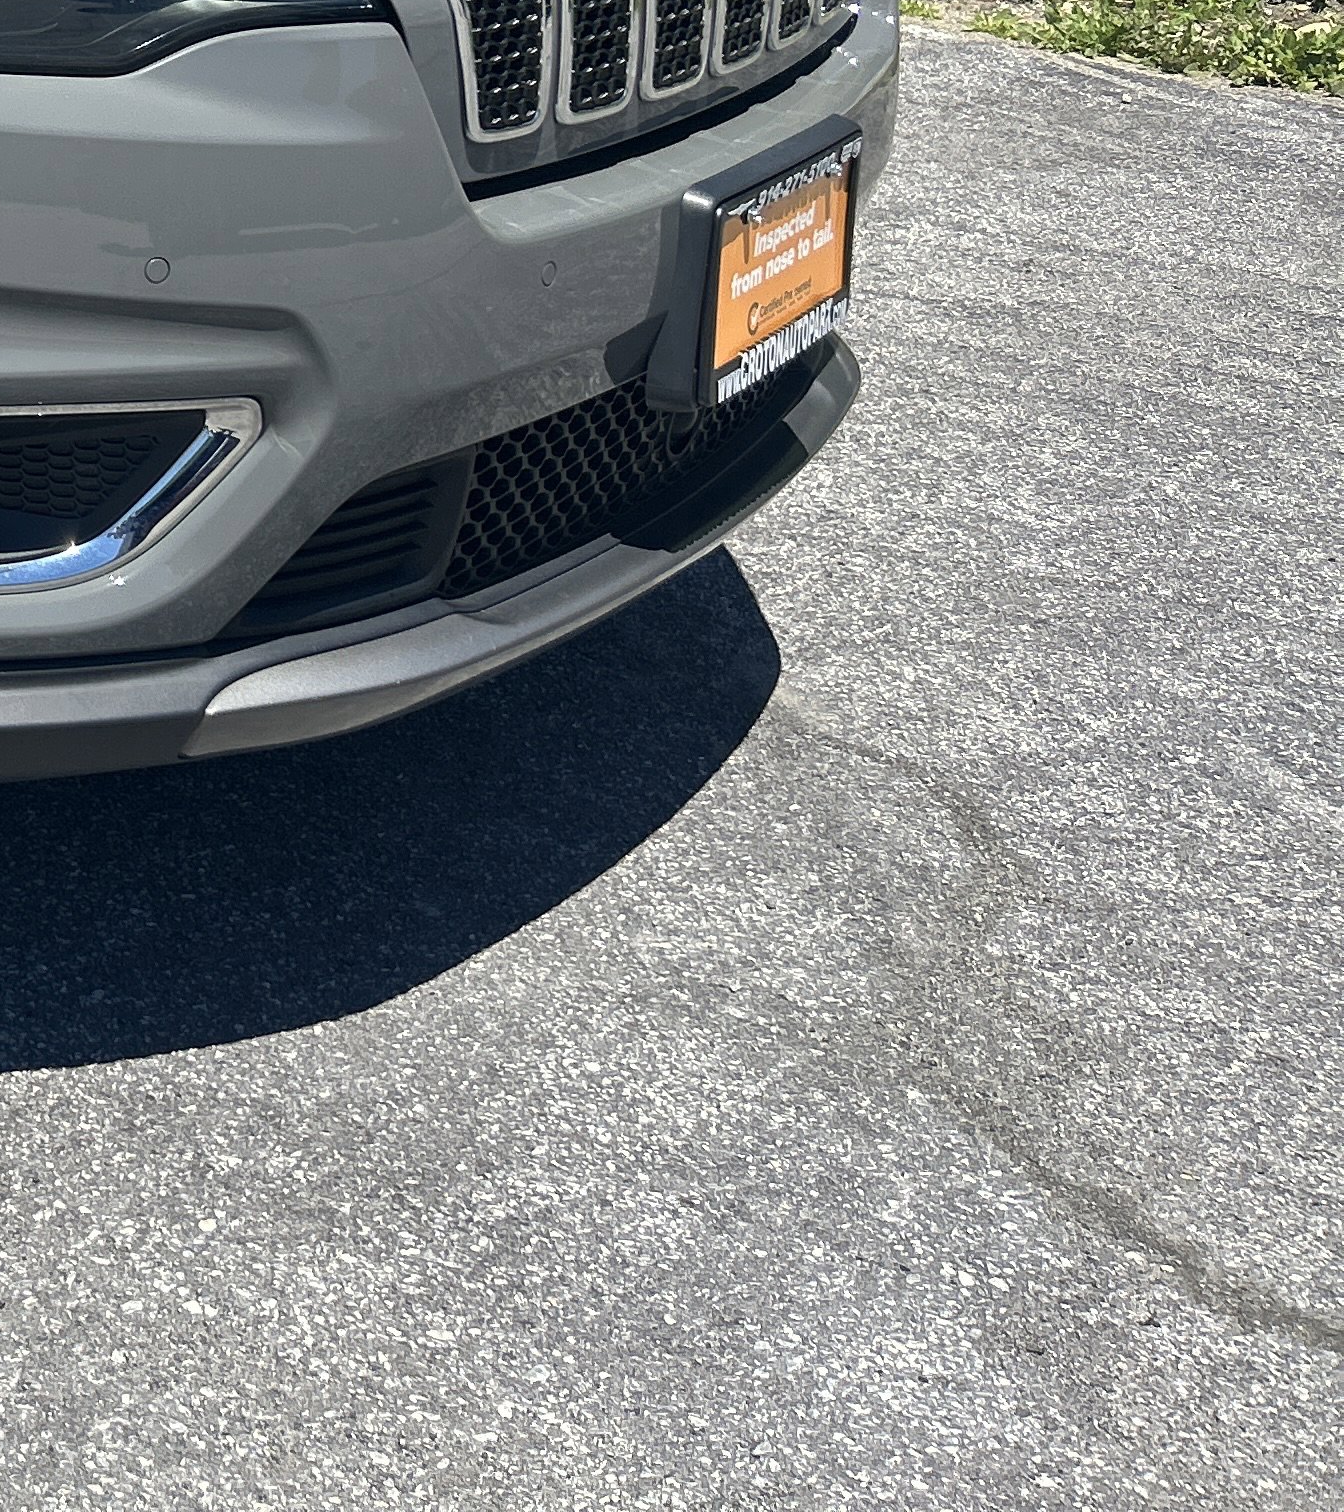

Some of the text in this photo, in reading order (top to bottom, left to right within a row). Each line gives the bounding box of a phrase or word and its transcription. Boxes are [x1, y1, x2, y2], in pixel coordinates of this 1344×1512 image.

[753, 200, 816, 258] Inspected
[730, 265, 763, 300] from
[765, 247, 795, 280] nose
[797, 237, 811, 260] to
